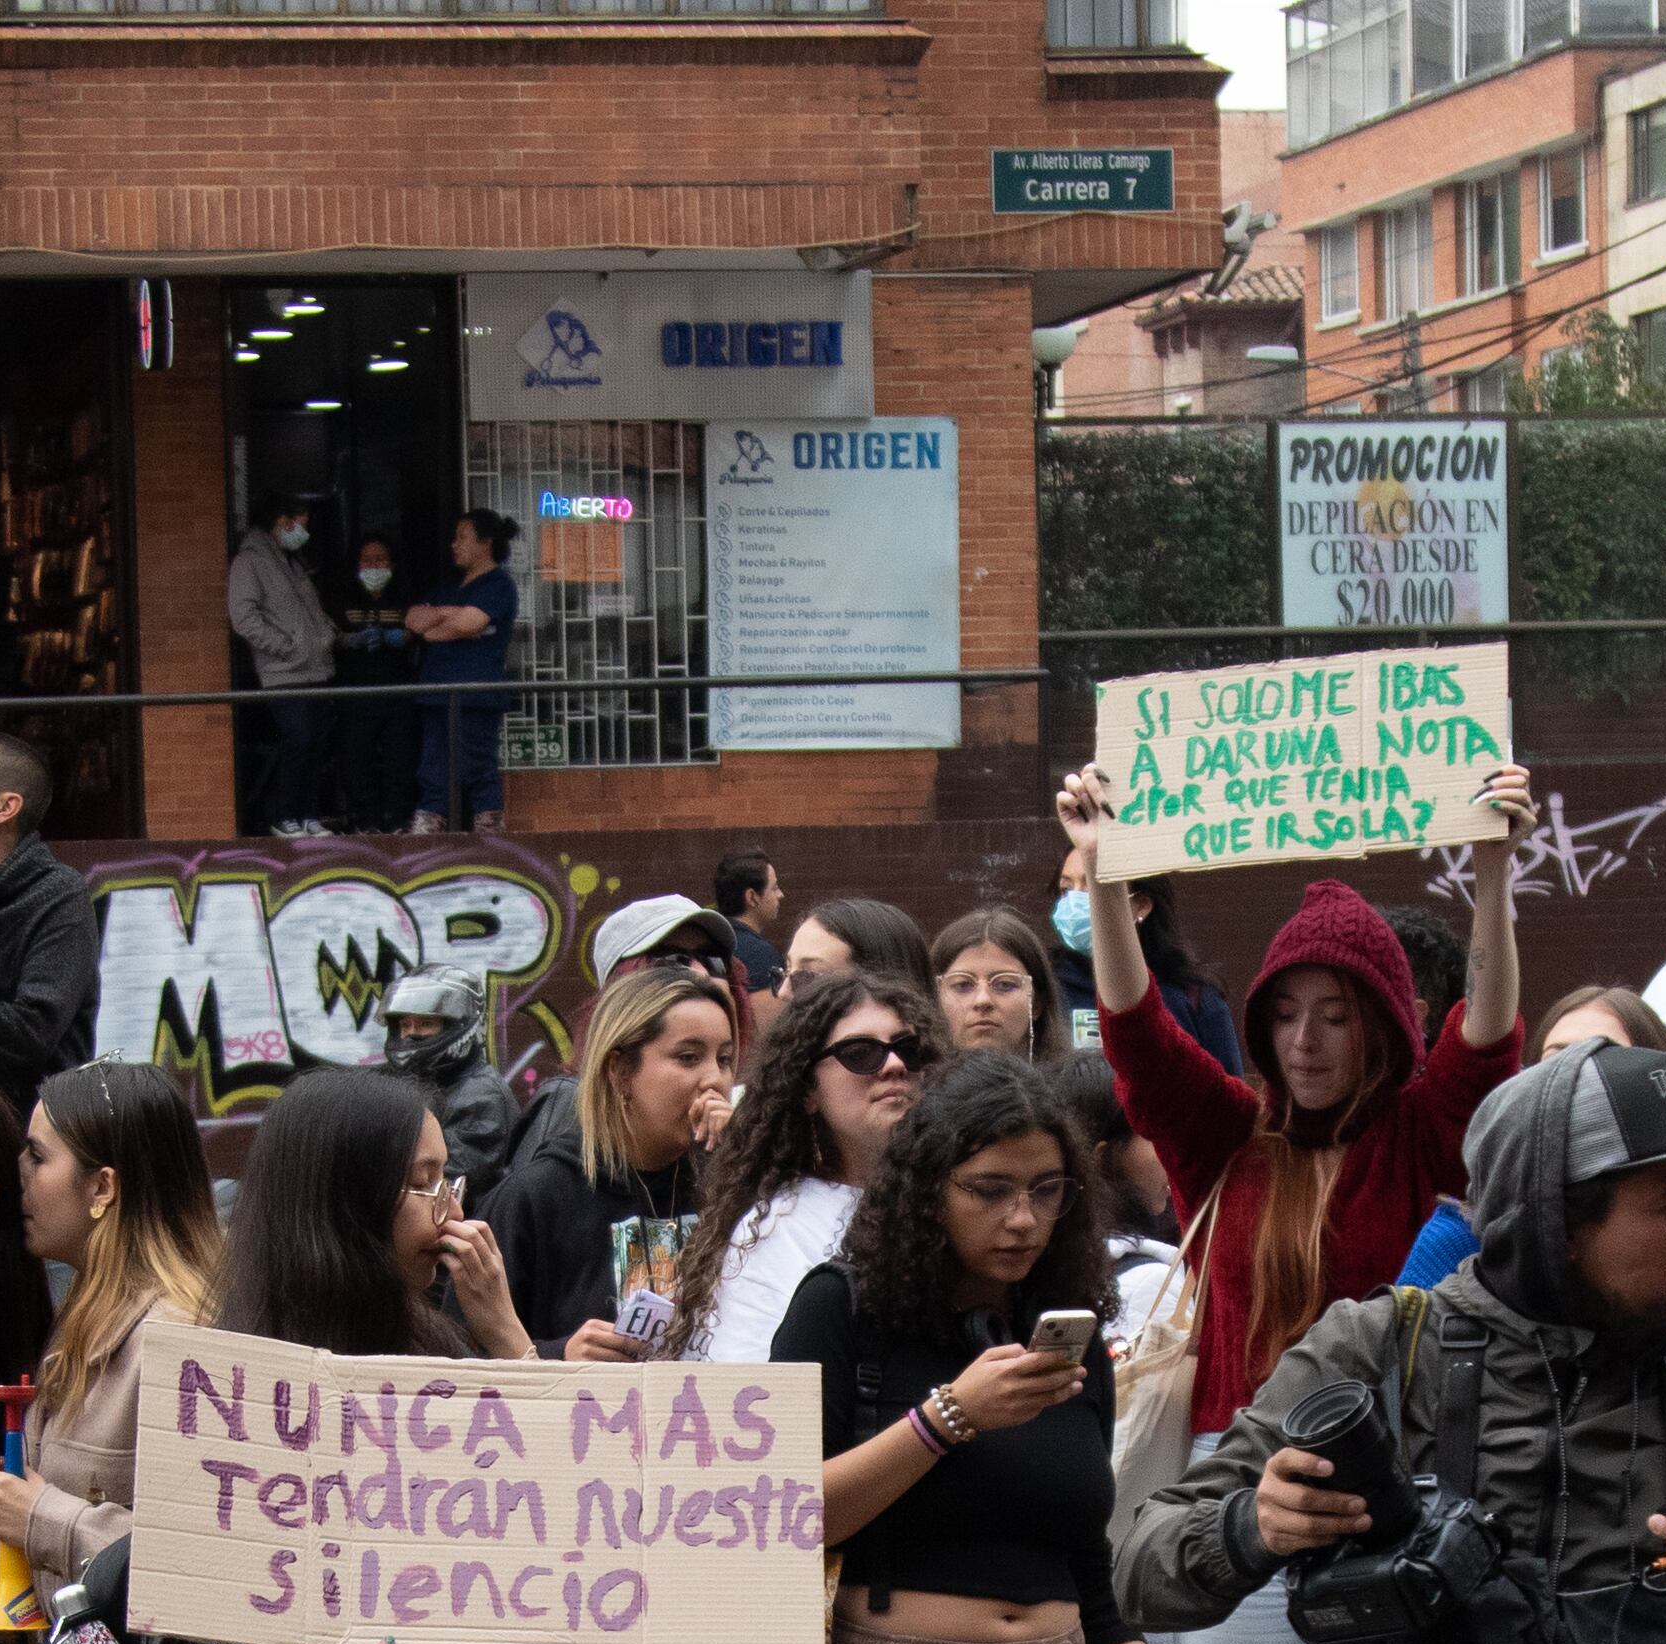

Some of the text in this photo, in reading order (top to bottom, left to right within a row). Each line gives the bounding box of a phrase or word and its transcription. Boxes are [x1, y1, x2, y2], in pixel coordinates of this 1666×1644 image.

[1013, 153, 1150, 173] Av. Alberto Lleras Camargo
[1025, 177, 1137, 201] Carrera 7
[660, 320, 844, 368] ORIGEN
[792, 431, 942, 471] ORIGEN
[1289, 420, 1500, 487] PROMOCIÓN
[539, 490, 633, 519] ABIERTO
[1287, 488, 1500, 535] DEPILACIÓN EN
[1310, 537, 1479, 576] CERA DESDE
[1336, 577, 1455, 626] $20.000
[1134, 686, 1171, 740] SI
[1289, 667, 1357, 720] ME
[1378, 660, 1466, 714] IBAS
[1129, 713, 1503, 791] A DAR UNA NOTA
[1224, 772, 1291, 813] QUE
[1181, 816, 1255, 862] QUE
[174, 1356, 527, 1461] NUNCA
